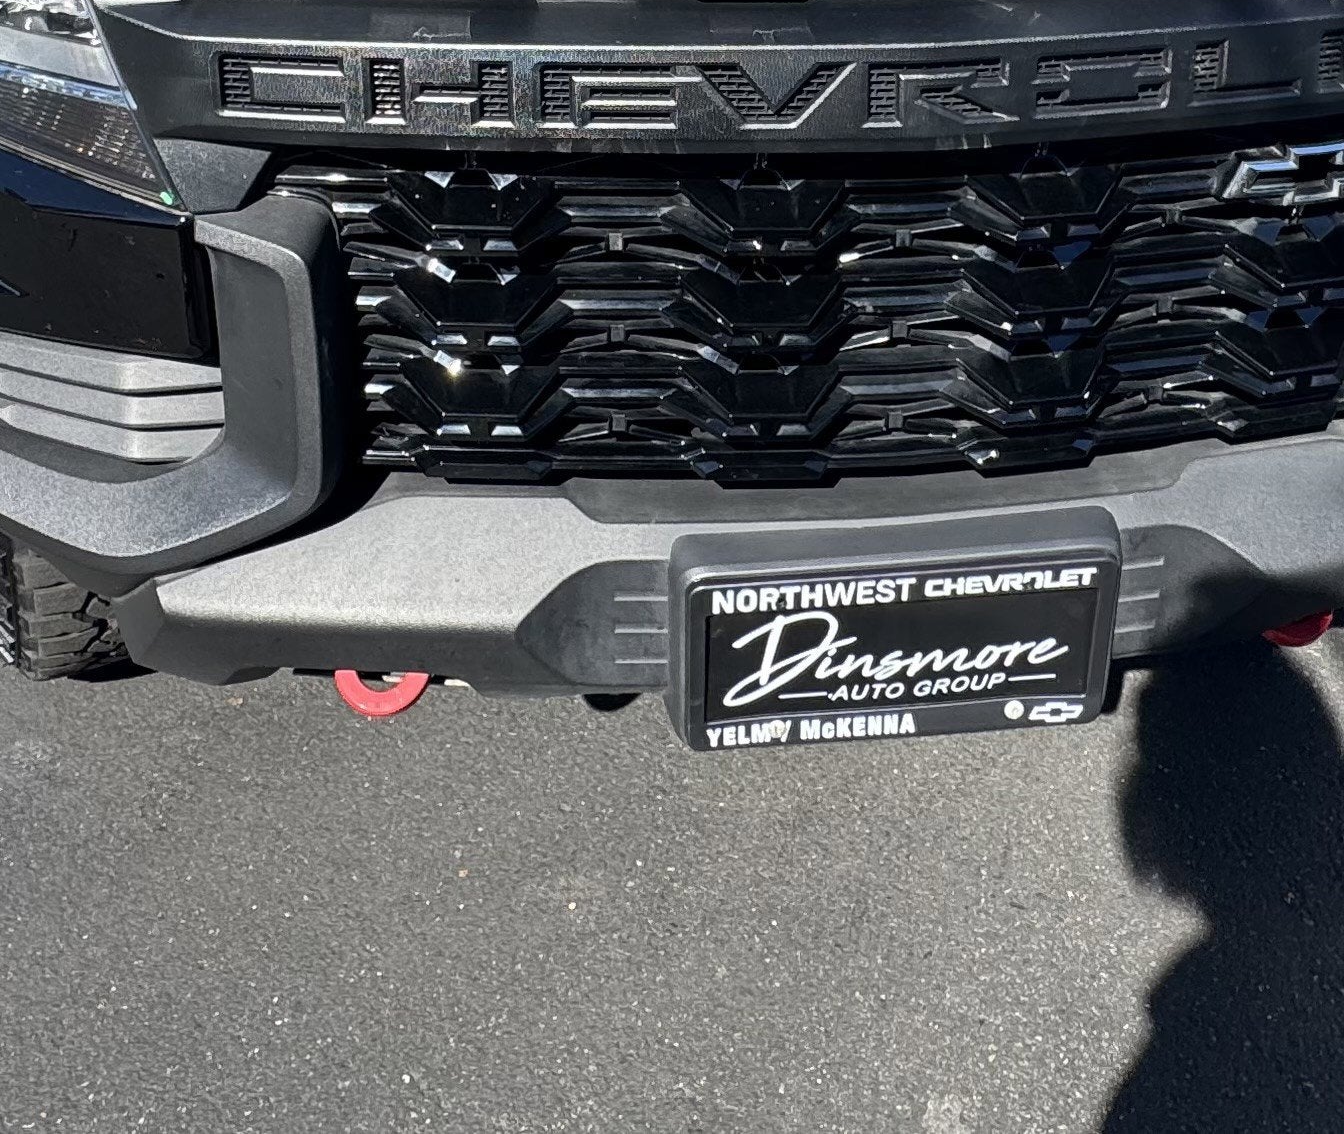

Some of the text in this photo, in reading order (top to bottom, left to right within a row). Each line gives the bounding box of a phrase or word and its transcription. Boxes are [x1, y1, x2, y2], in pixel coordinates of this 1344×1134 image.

[712, 567, 1098, 615] NORTHWEST CHEVROLET
[722, 610, 1070, 708] Dinsmore
[829, 672, 1007, 702] AUTO GROUP
[799, 713, 917, 741] McKENNA
